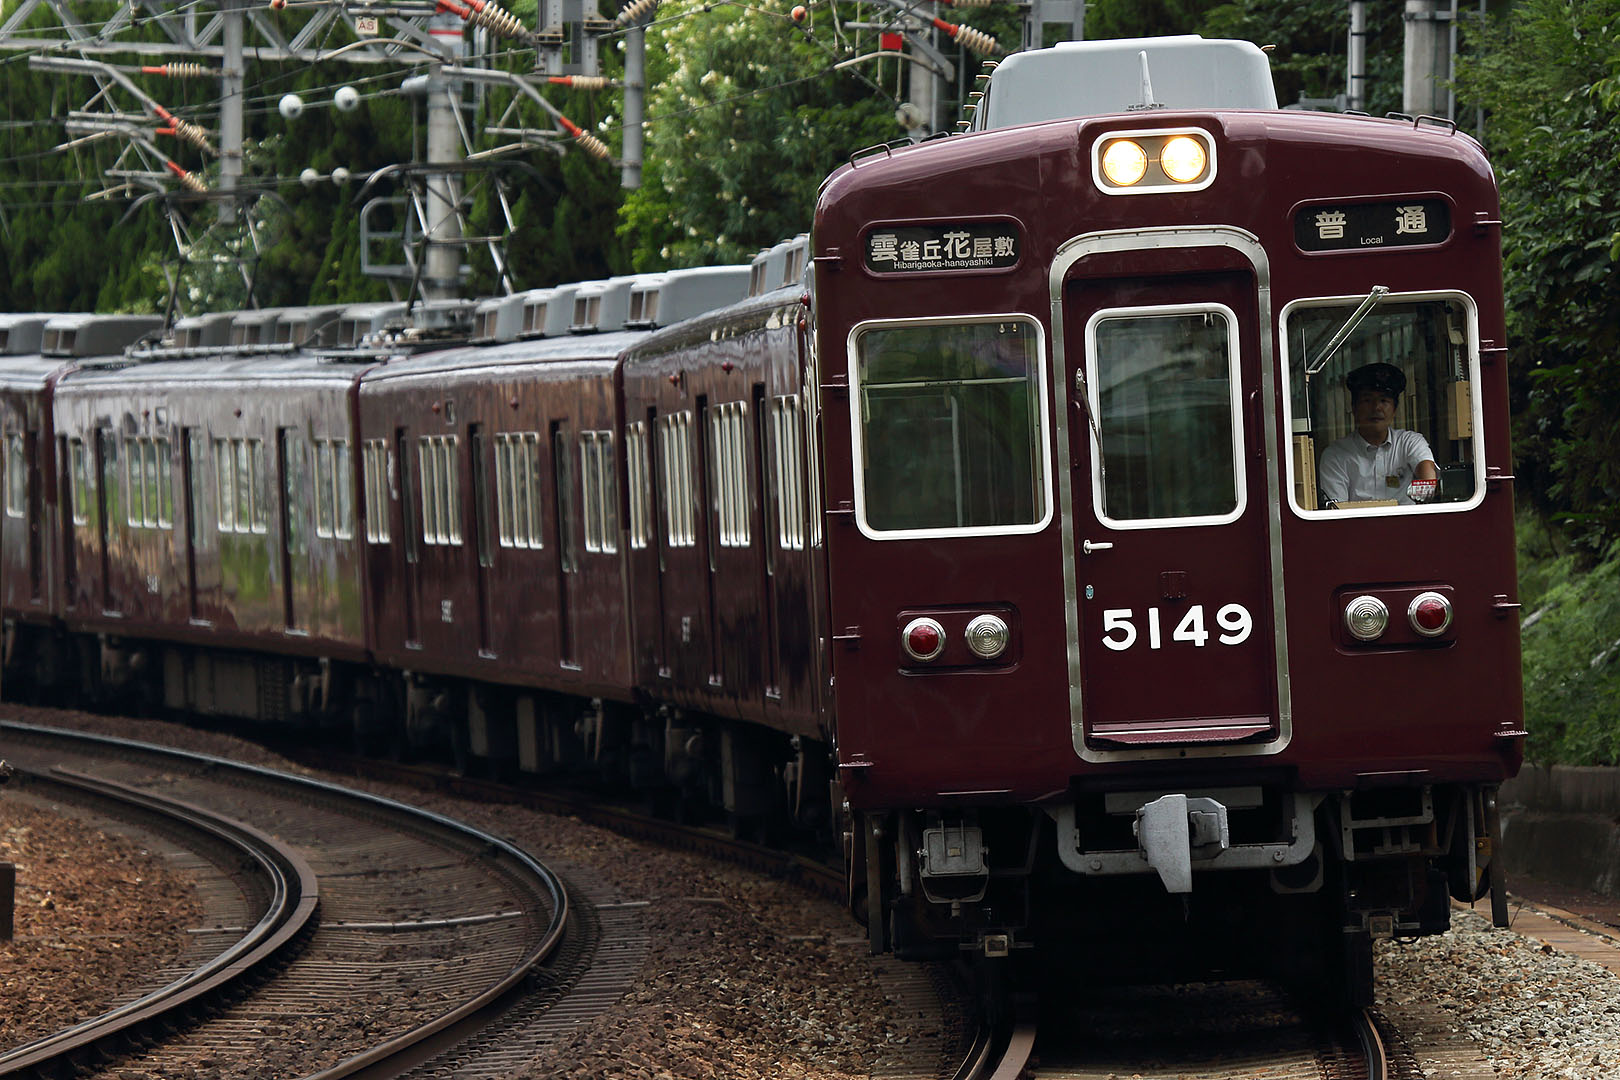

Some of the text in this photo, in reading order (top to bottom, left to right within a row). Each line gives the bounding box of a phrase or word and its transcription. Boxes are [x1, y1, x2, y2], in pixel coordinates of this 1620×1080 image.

[870, 230, 1015, 262] 雲雀丘花屋敷
[1360, 236, 1383, 245] Local
[893, 258, 993, 270] Hibarigaoka-hanayashiki
[1101, 603, 1253, 651] 5149
